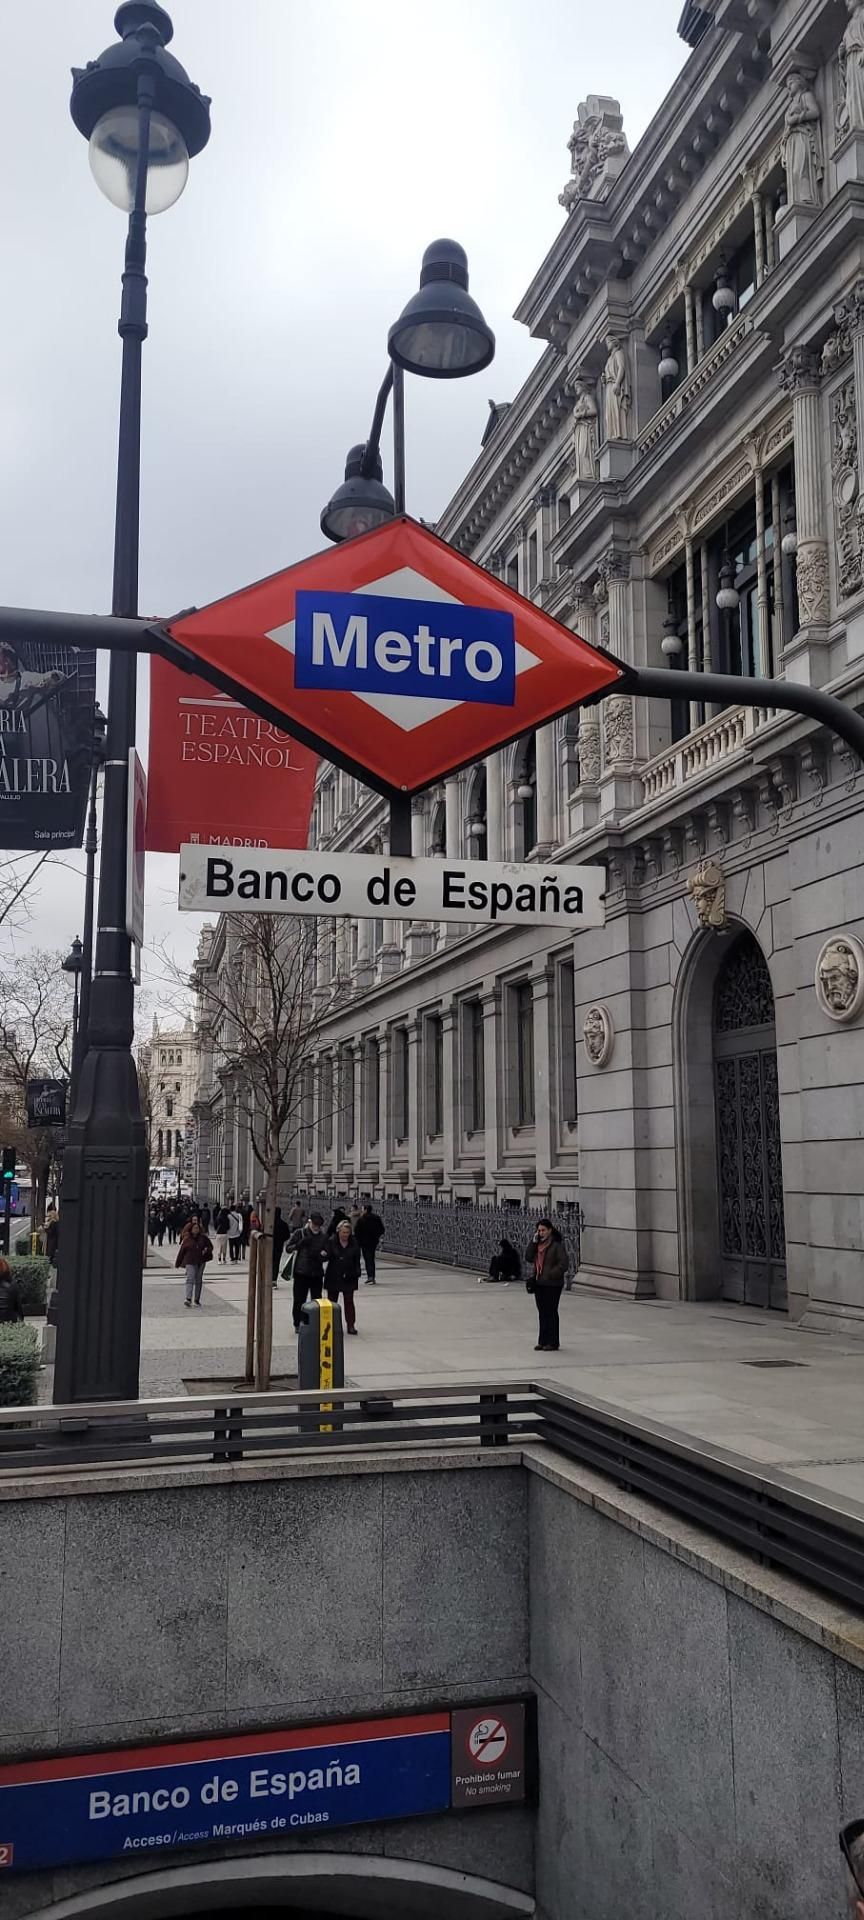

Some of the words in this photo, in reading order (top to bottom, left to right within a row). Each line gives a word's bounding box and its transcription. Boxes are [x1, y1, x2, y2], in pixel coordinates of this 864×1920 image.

[311, 611, 503, 682] Metro
[182, 741, 304, 771] ESPAÑOL
[34, 829, 50, 839] Sala
[209, 835, 268, 849] MADRID
[205, 857, 342, 903] Banco
[366, 868, 417, 907] de
[442, 870, 584, 919] España
[89, 1786, 190, 1820] Banco
[200, 1775, 239, 1805] de
[249, 1759, 361, 1800] España
[455, 1773, 495, 1785] Prohibido
[497, 1770, 520, 1779] fumar
[465, 1786, 477, 1796] No
[478, 1783, 511, 1794] smoking
[212, 1818, 267, 1837] Marqués
[271, 1816, 286, 1829] de
[289, 1810, 330, 1826] Cubas
